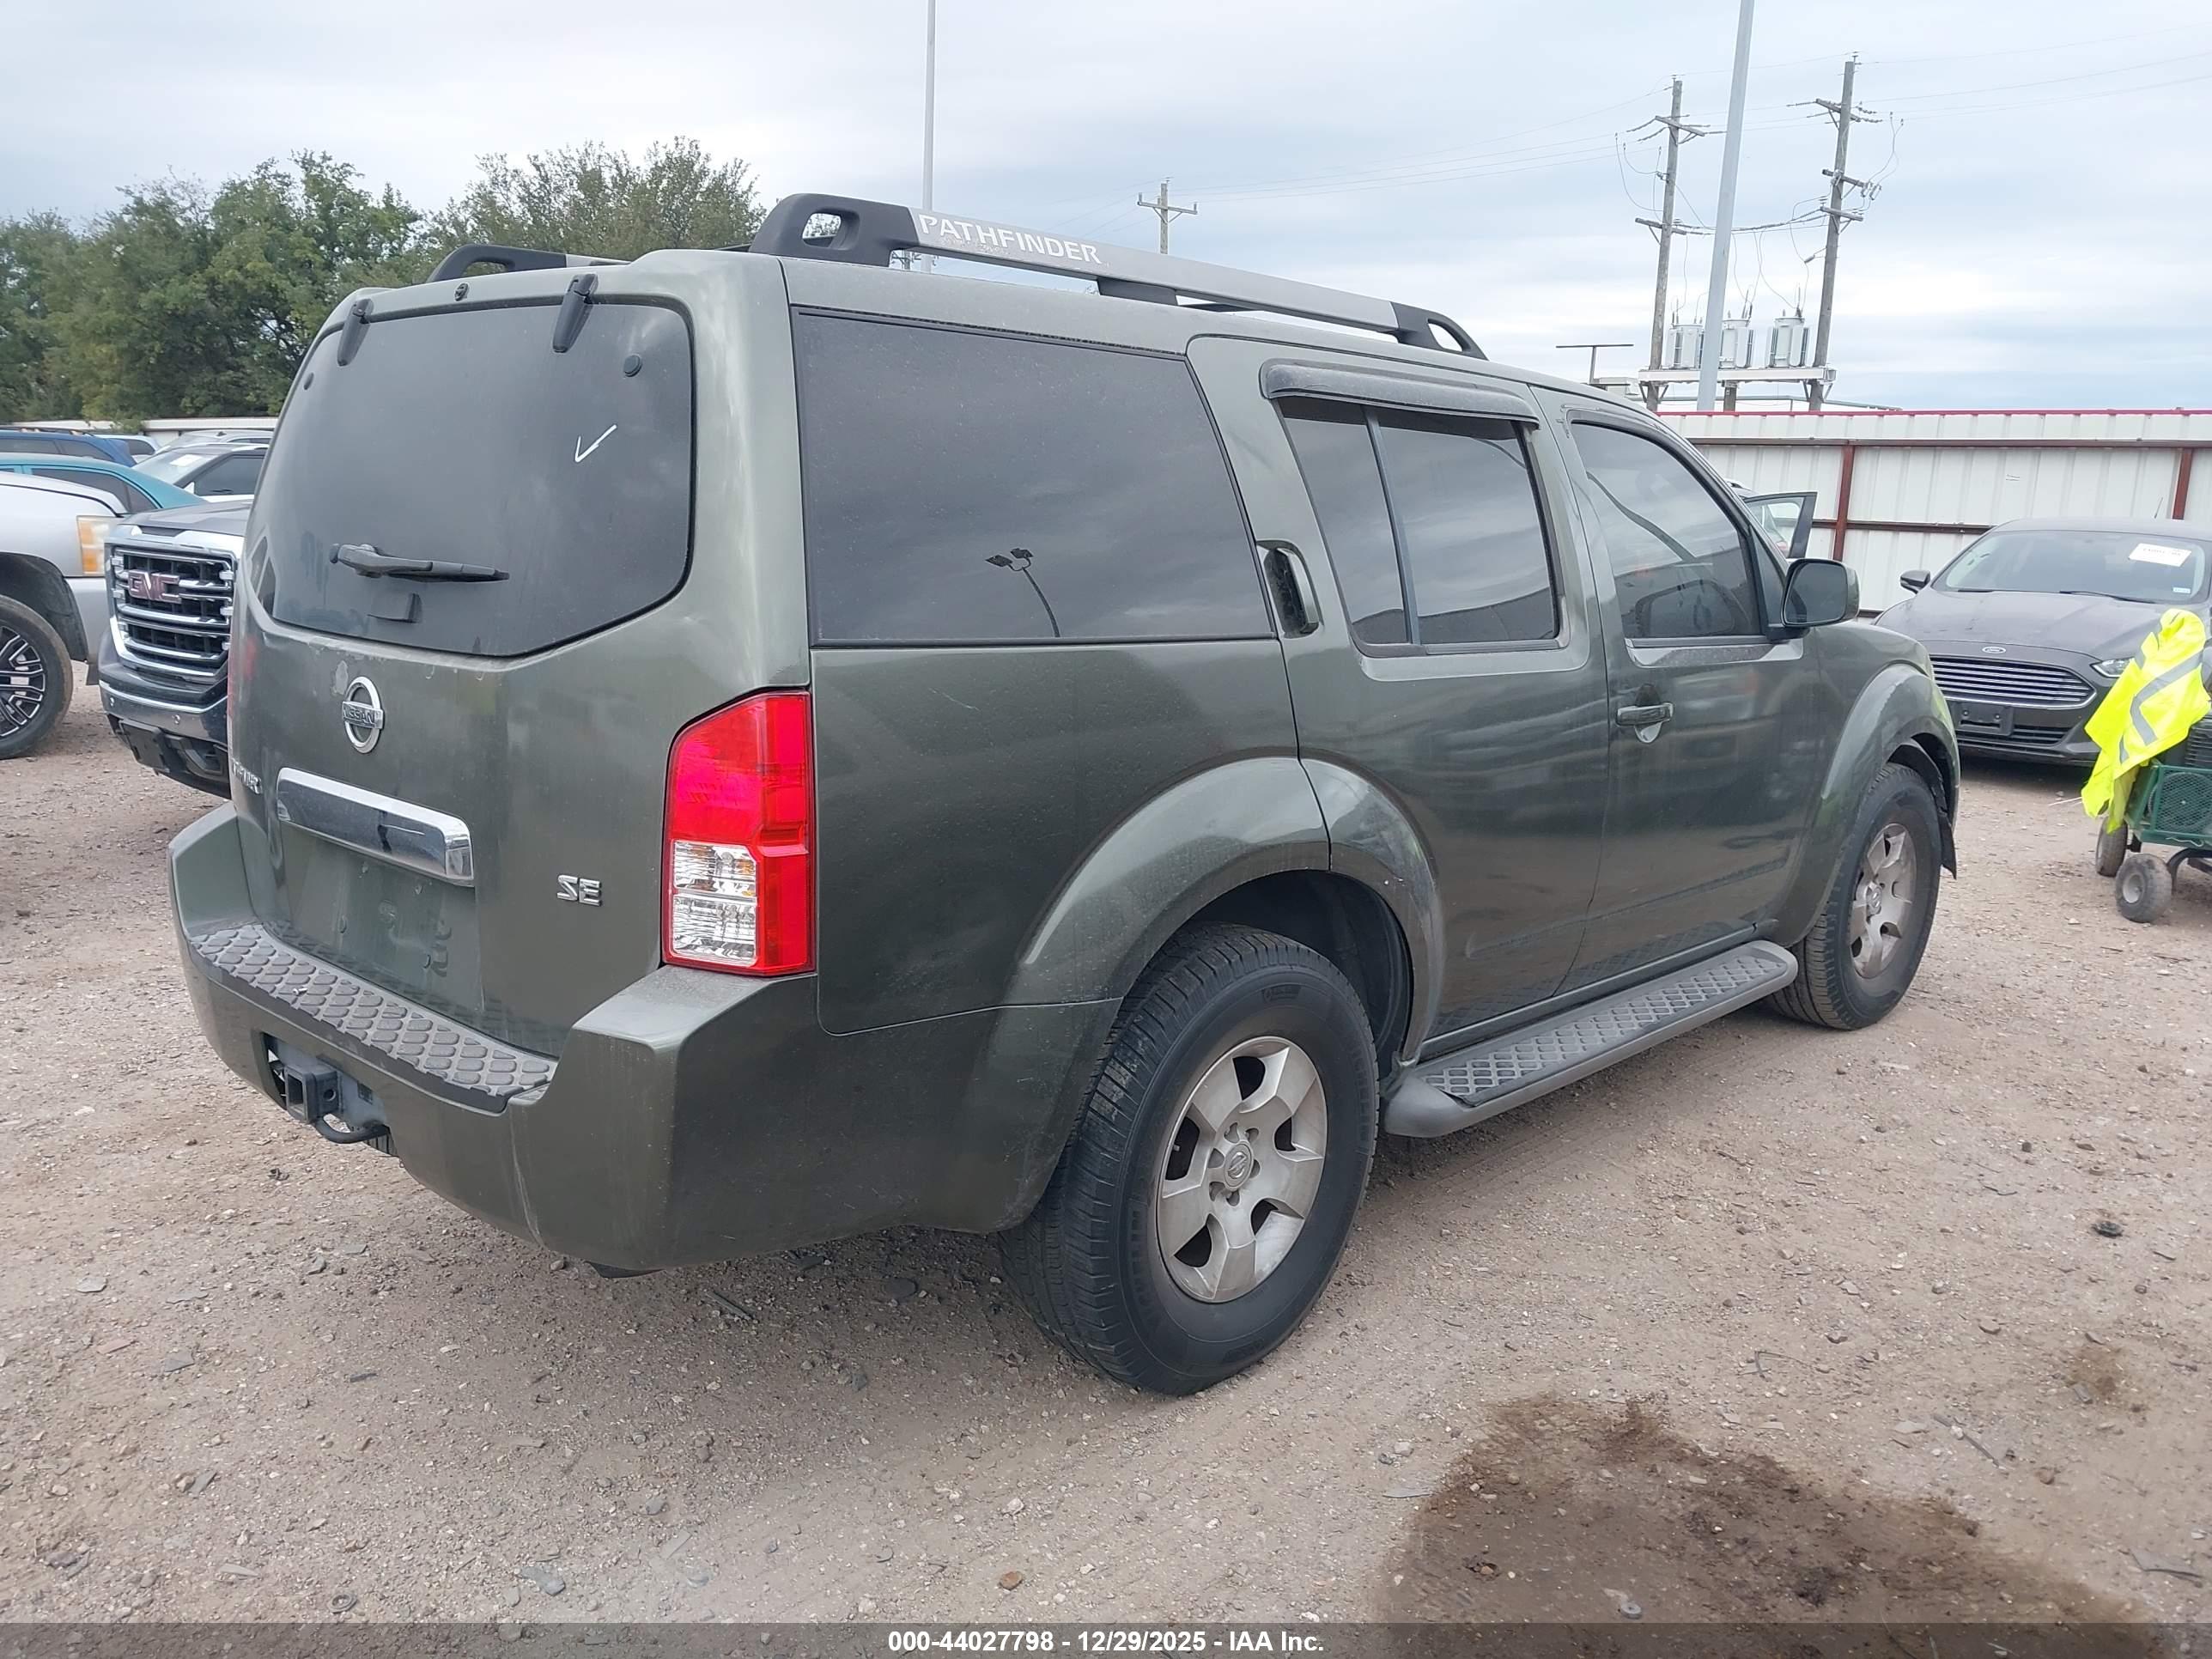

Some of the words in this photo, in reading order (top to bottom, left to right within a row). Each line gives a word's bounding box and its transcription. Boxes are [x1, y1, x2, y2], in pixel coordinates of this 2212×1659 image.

[919, 215, 1102, 264] PATHFINDER
[128, 570, 182, 604] GMC
[557, 875, 600, 906] SE
